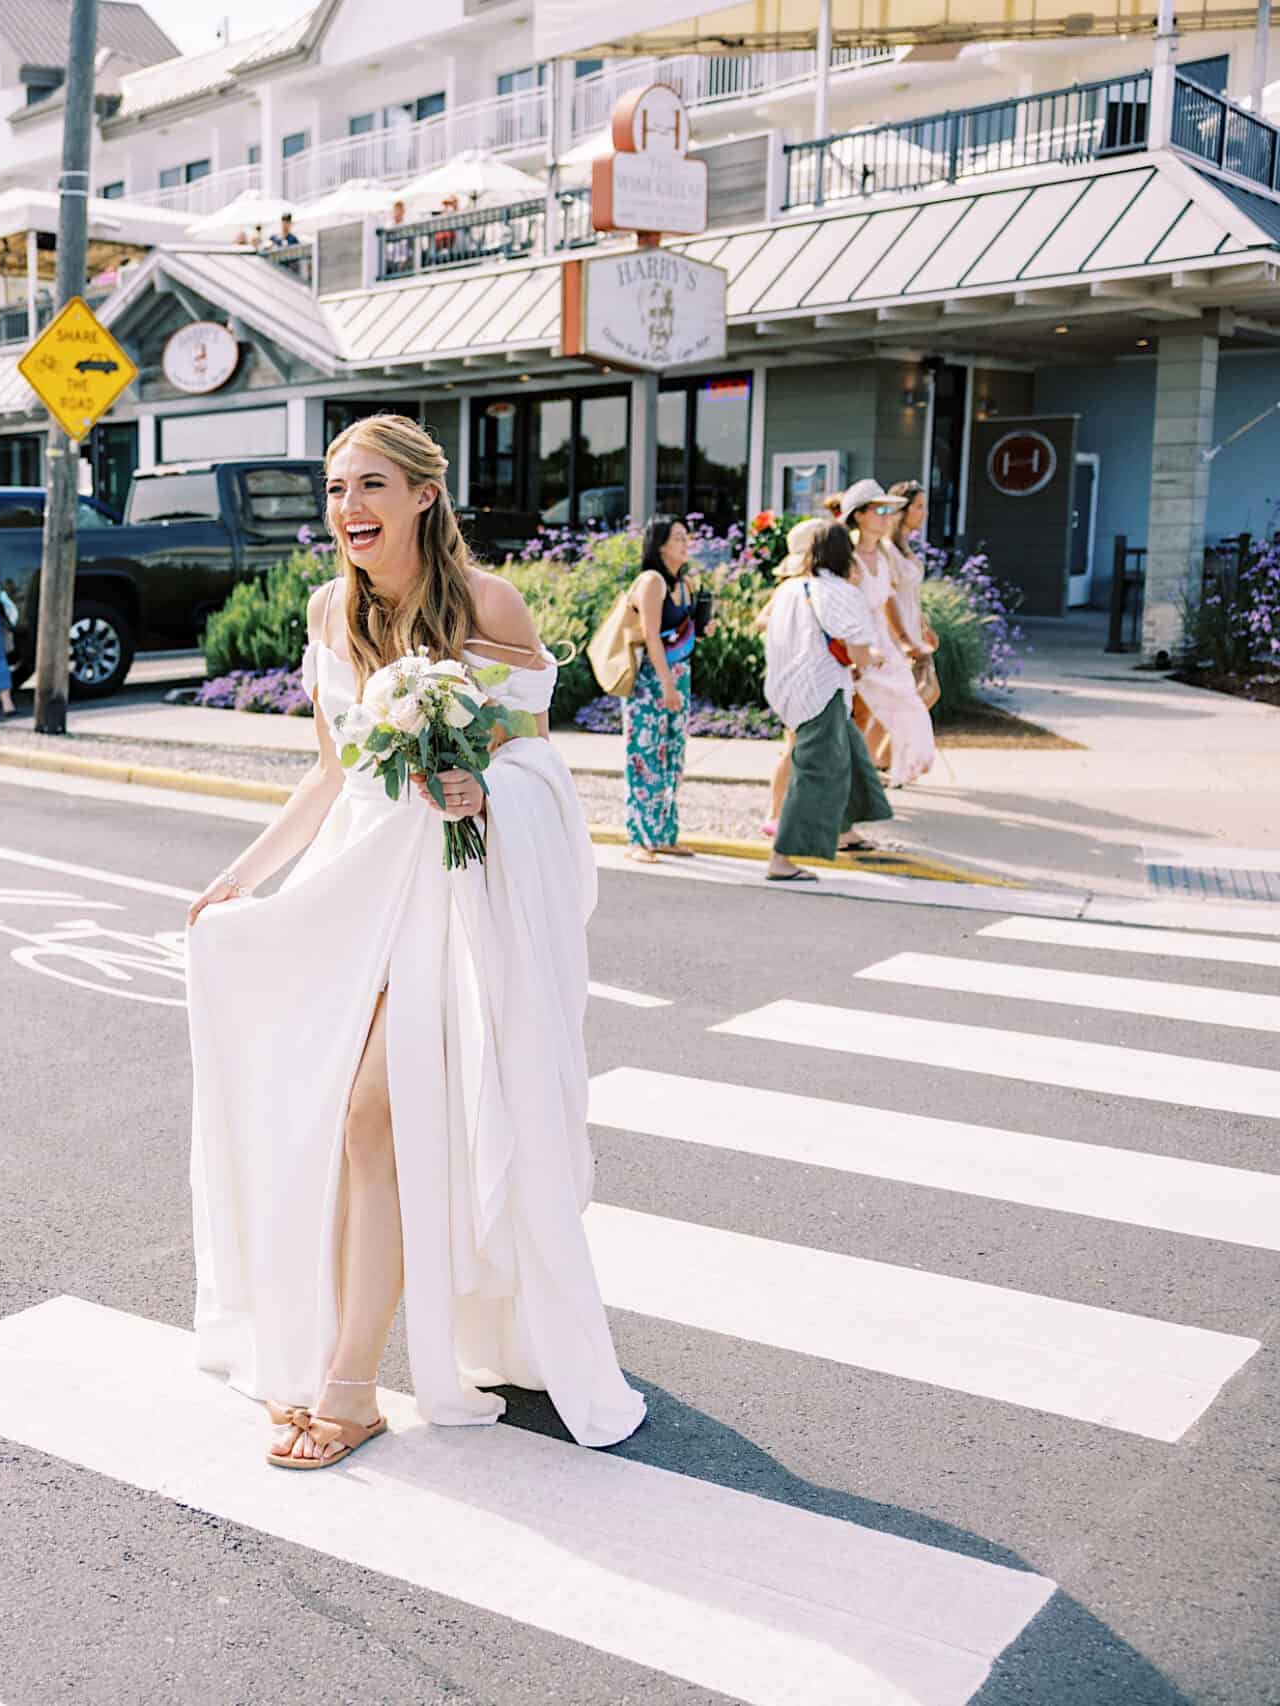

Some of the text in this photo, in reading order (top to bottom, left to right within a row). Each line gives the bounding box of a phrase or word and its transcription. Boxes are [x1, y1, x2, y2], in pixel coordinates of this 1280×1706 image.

[616, 256, 699, 292] HARRY'S
[57, 329, 98, 344] SHARE
[66, 378, 88, 392] THE
[61, 397, 94, 410] ROAD
